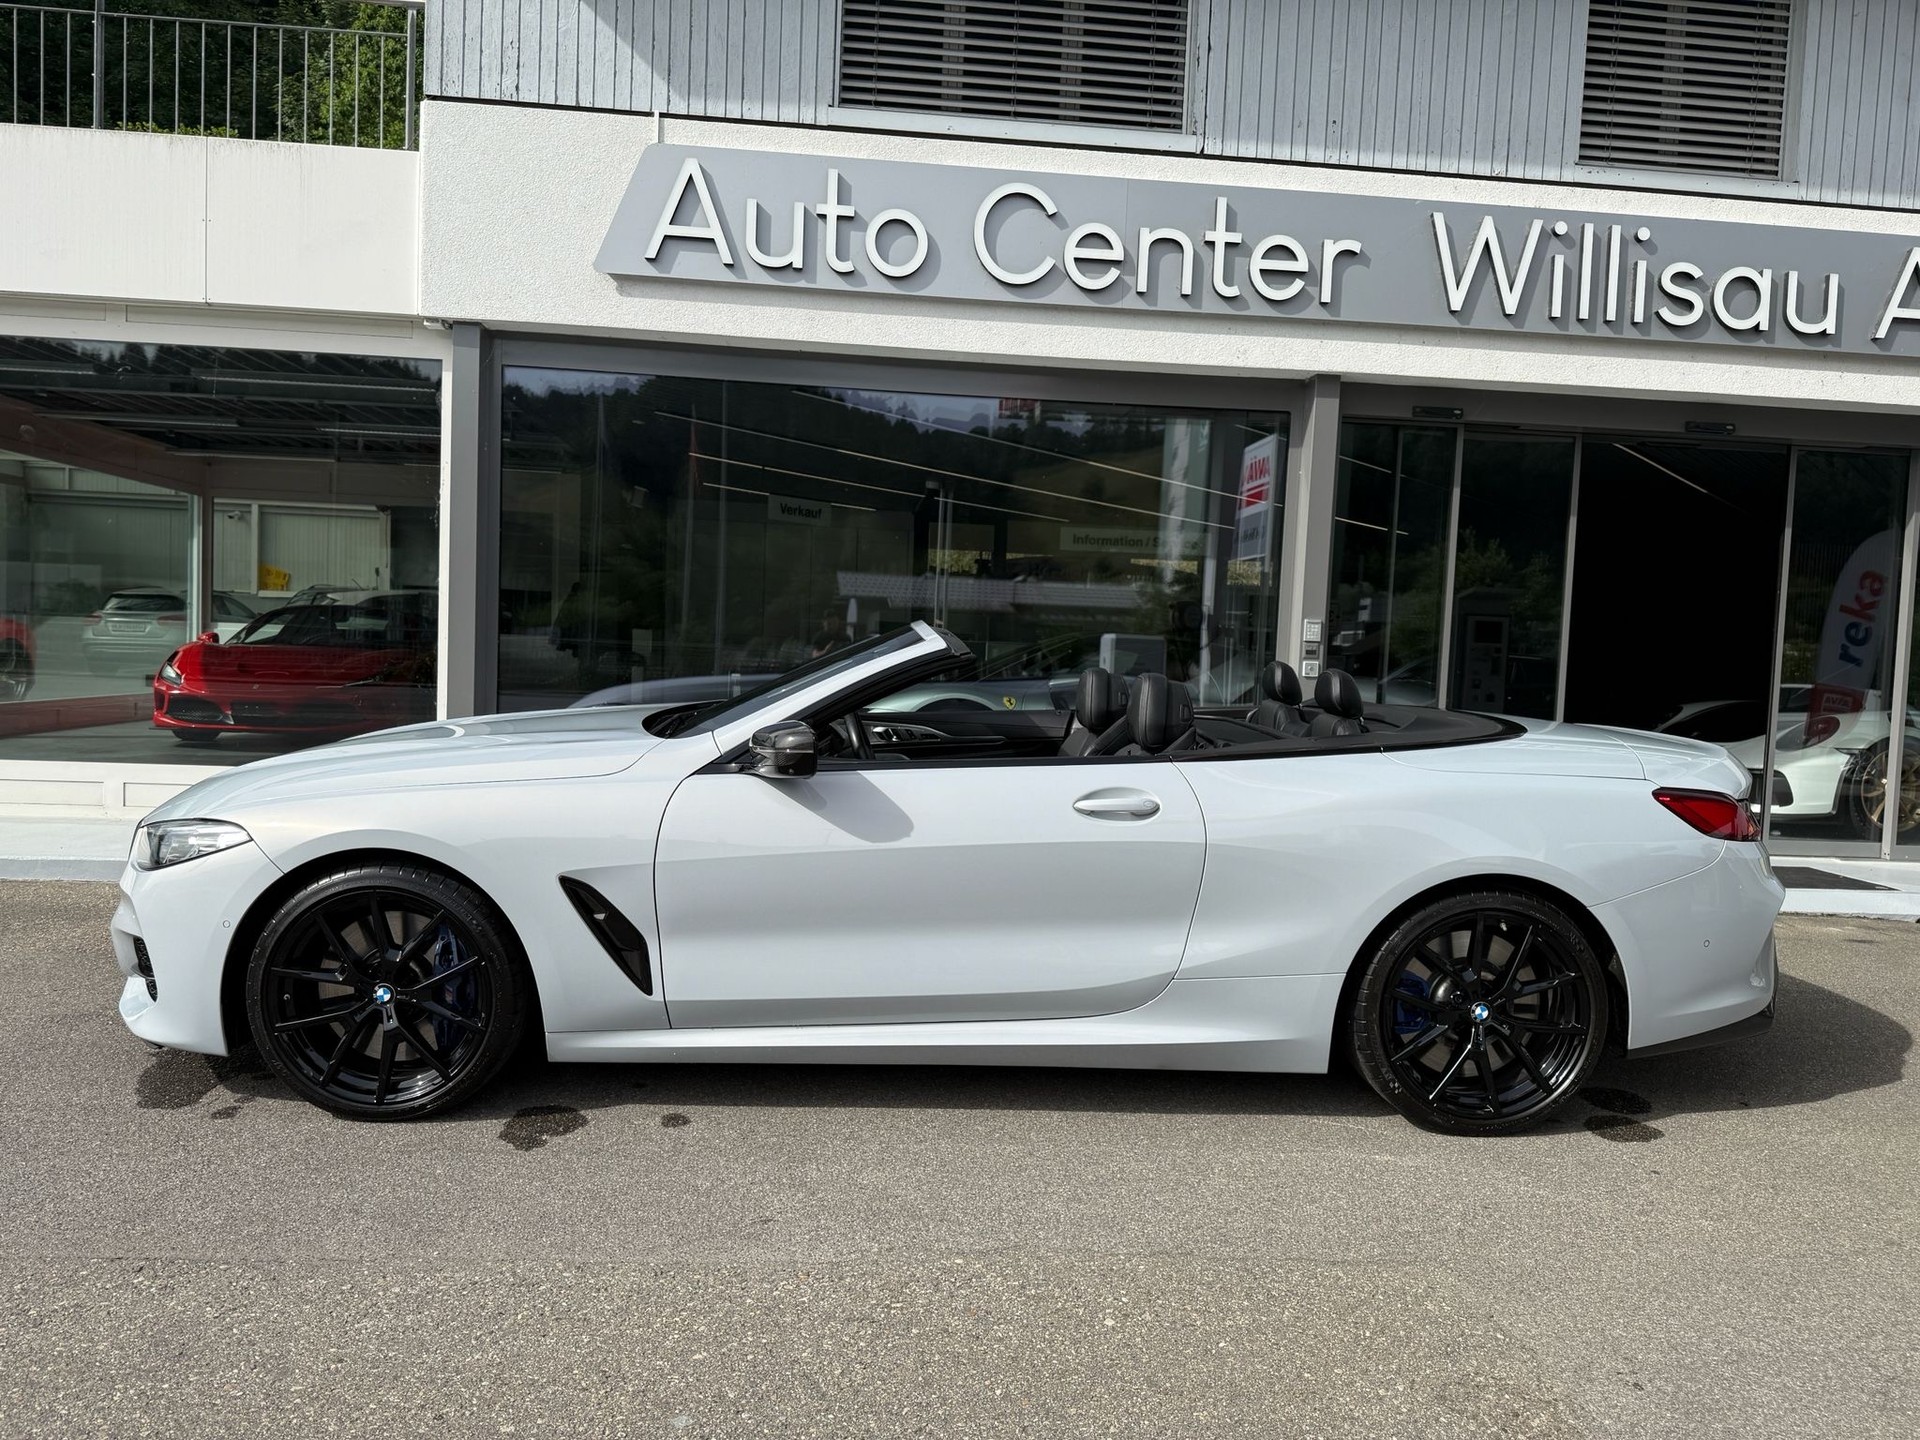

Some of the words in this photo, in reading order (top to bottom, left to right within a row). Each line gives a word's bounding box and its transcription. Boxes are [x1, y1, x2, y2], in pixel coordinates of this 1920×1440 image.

[644, 157, 929, 279] Auto
[973, 182, 1362, 304] Center
[1430, 211, 1840, 335] Willisau
[780, 503, 822, 518] Verkauf
[1072, 533, 1143, 548] Information
[1839, 571, 1885, 667] reka
